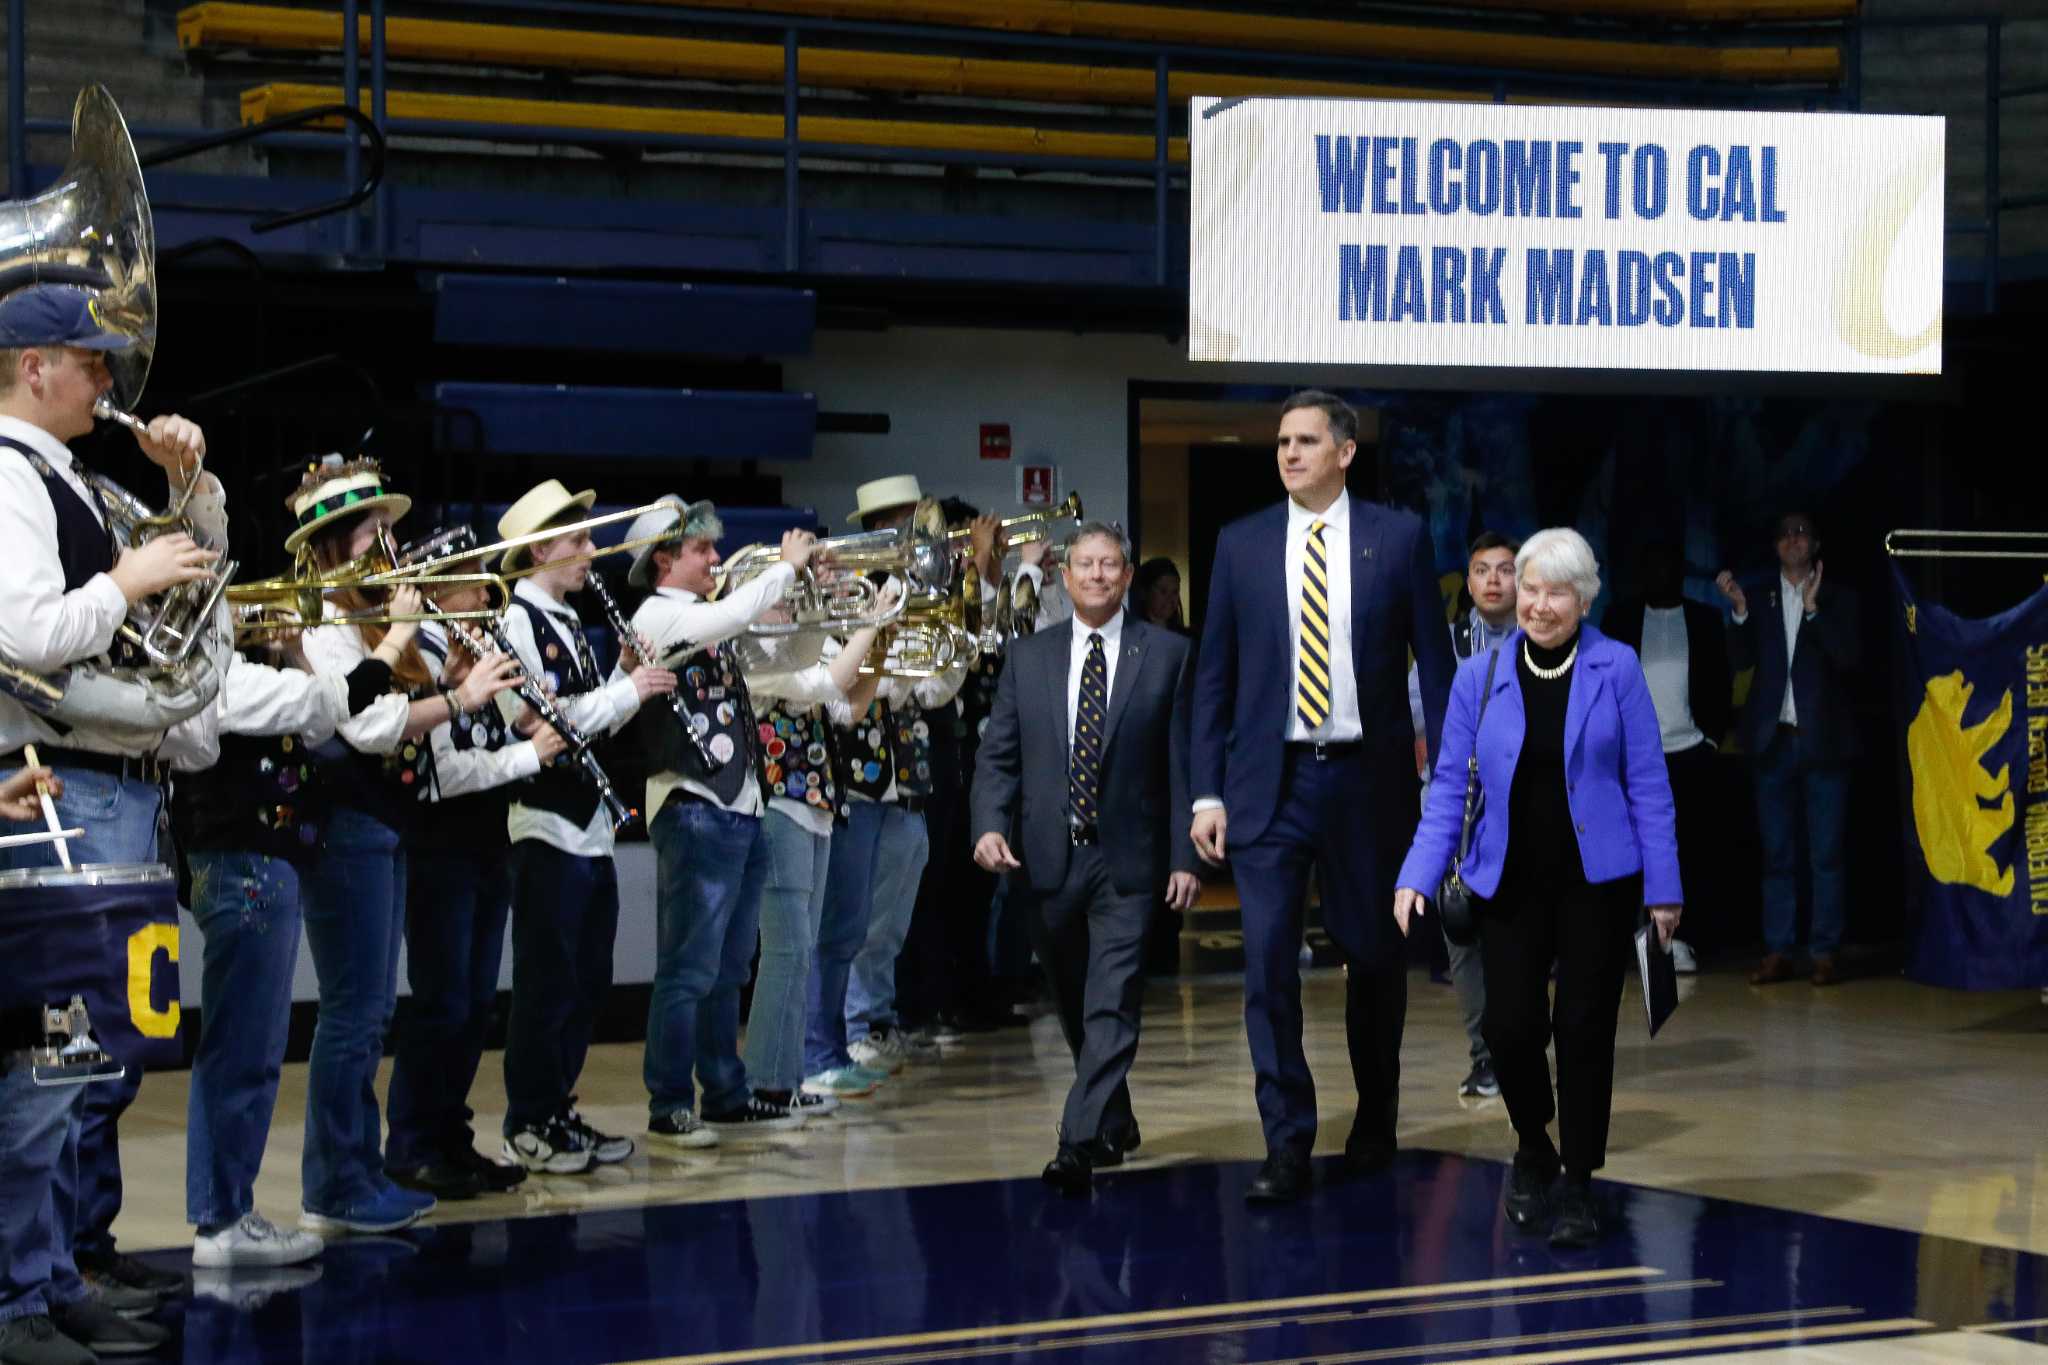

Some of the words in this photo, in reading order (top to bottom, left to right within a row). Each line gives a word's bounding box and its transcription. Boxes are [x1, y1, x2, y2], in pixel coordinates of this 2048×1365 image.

[1314, 134, 1583, 218] WELCOME
[1599, 142, 1667, 221] TO
[1687, 144, 1786, 223] CAL
[1339, 244, 1507, 325] MARK
[1526, 247, 1756, 330] MADSEN
[127, 921, 181, 1039] C
